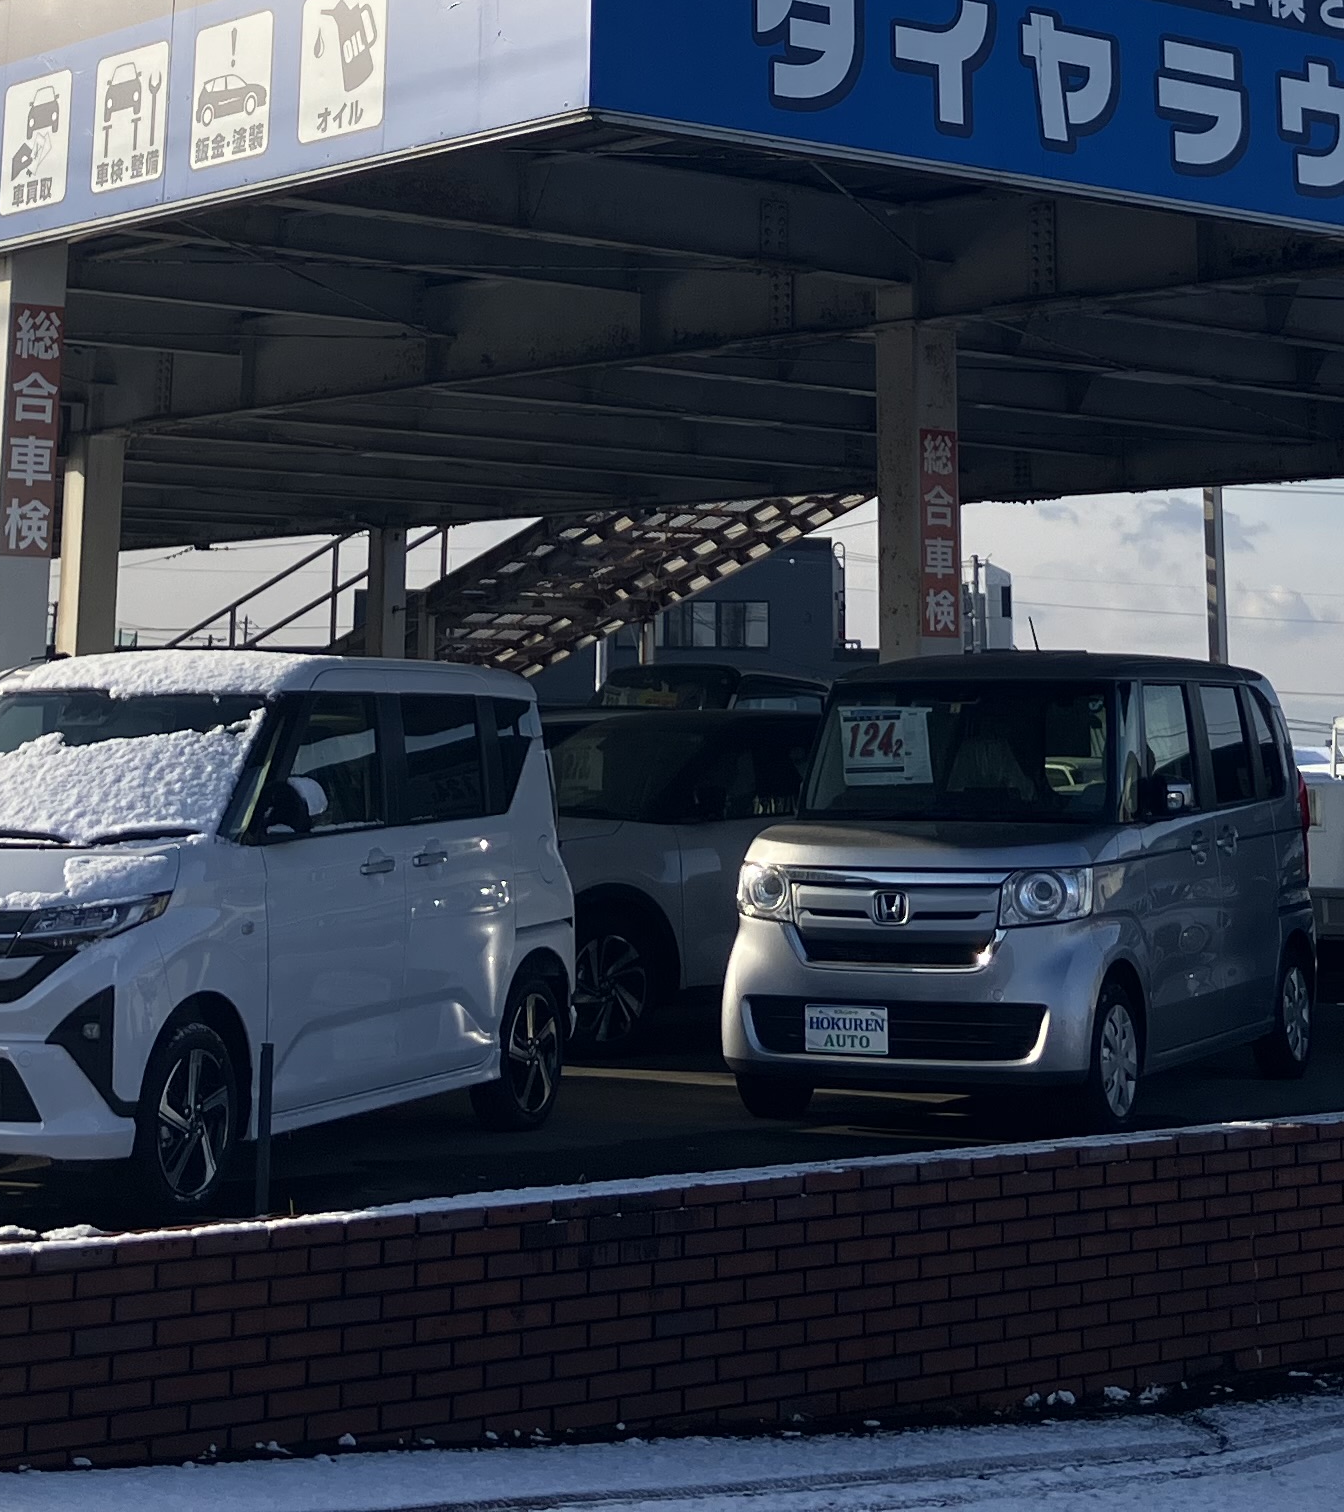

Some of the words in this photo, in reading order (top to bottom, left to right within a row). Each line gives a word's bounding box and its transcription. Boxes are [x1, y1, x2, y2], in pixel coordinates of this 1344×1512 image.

[342, 31, 366, 65] OIL
[316, 99, 365, 135] オイル
[194, 122, 266, 164] 鈑金・塗装
[95, 149, 161, 188] 車検・整備
[11, 176, 54, 207] 車買取
[4, 308, 61, 552] 総合車検
[923, 433, 956, 633] 総合車検
[809, 1016, 885, 1033] HOKUREN
[823, 1033, 871, 1049] AUTO
